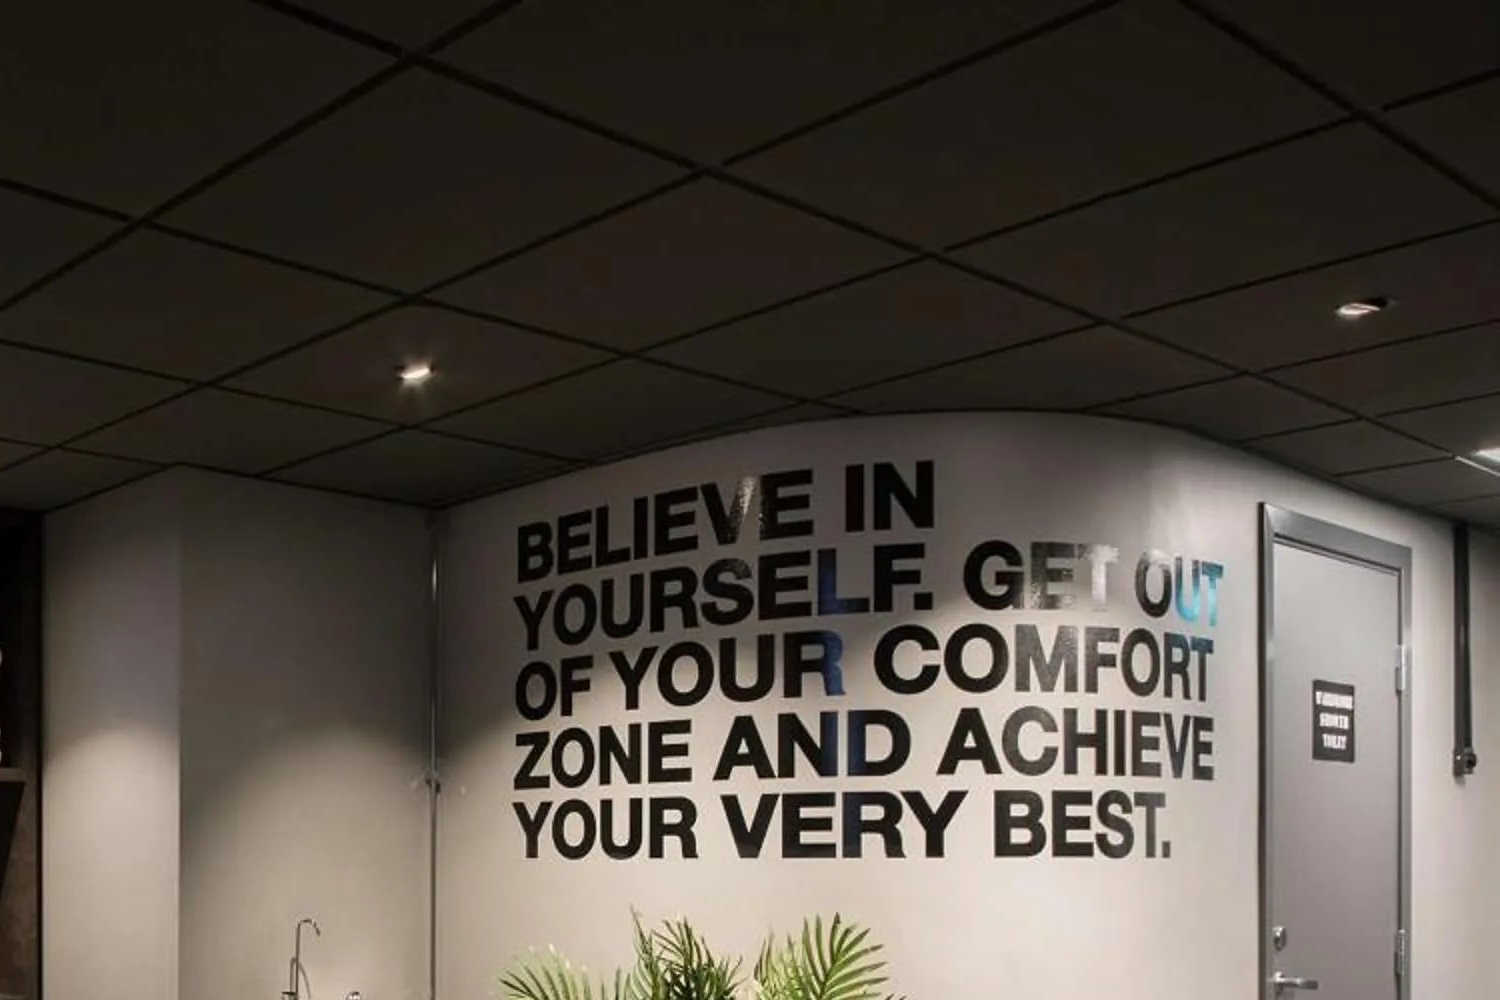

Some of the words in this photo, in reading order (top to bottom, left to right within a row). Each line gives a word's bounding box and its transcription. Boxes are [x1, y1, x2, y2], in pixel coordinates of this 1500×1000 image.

[516, 468, 814, 584] BELIEVE
[844, 459, 935, 533] IN
[513, 542, 934, 652] YOURSELF.
[962, 539, 1119, 612] GET
[1134, 548, 1224, 628] OUT
[514, 654, 594, 722] OF
[608, 629, 846, 712] YOUR
[873, 622, 1215, 702] COMFORT
[513, 718, 693, 791] ZONE
[712, 708, 912, 782] AND
[935, 705, 1215, 782] ACHIEVE
[512, 796, 700, 861] YOUR
[719, 790, 970, 860] VERY
[993, 789, 1172, 860] BEST.
